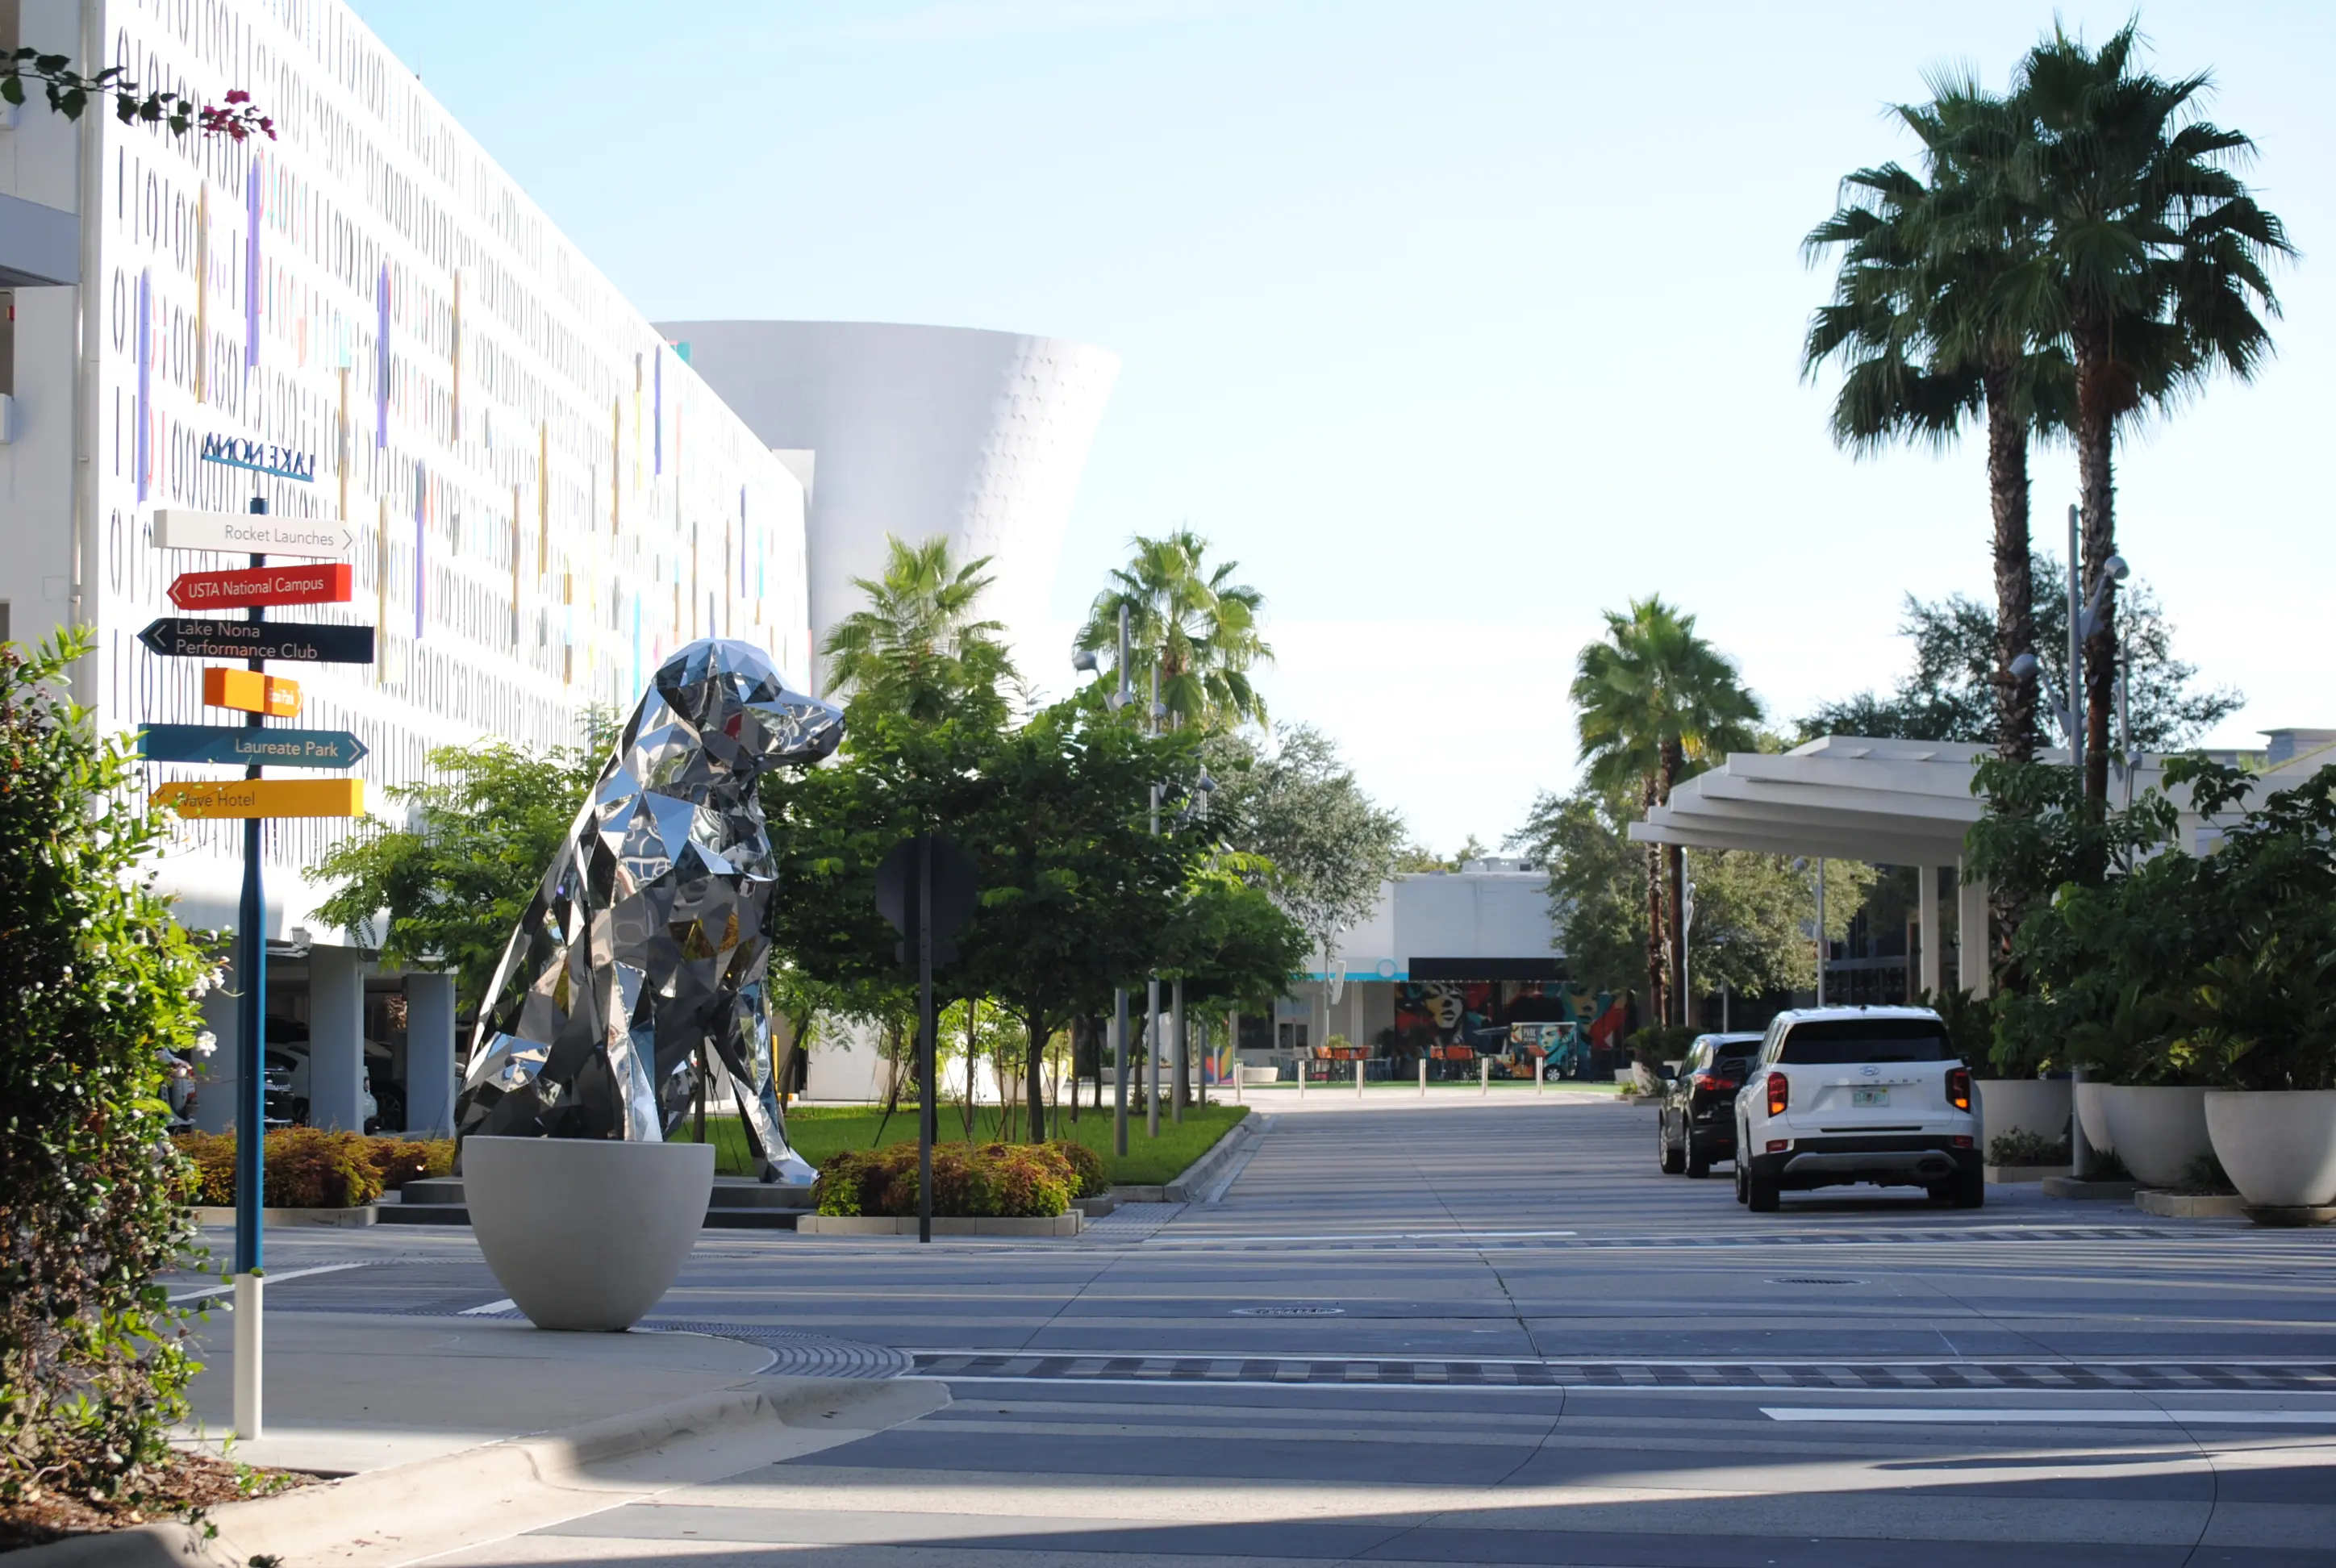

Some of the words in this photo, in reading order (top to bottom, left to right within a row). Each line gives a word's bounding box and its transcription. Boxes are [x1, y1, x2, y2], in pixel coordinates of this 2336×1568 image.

[225, 524, 270, 542] Rocket
[274, 528, 335, 546] Launches
[188, 582, 220, 598] USTA
[223, 578, 272, 596] National
[275, 578, 324, 595] Campus
[177, 620, 213, 636] Lake
[218, 622, 261, 638] Nona
[176, 639, 276, 657] Performance
[282, 644, 318, 659] Club
[236, 738, 301, 755] Laureate
[305, 741, 339, 757] Park
[218, 791, 255, 806] Hotel
